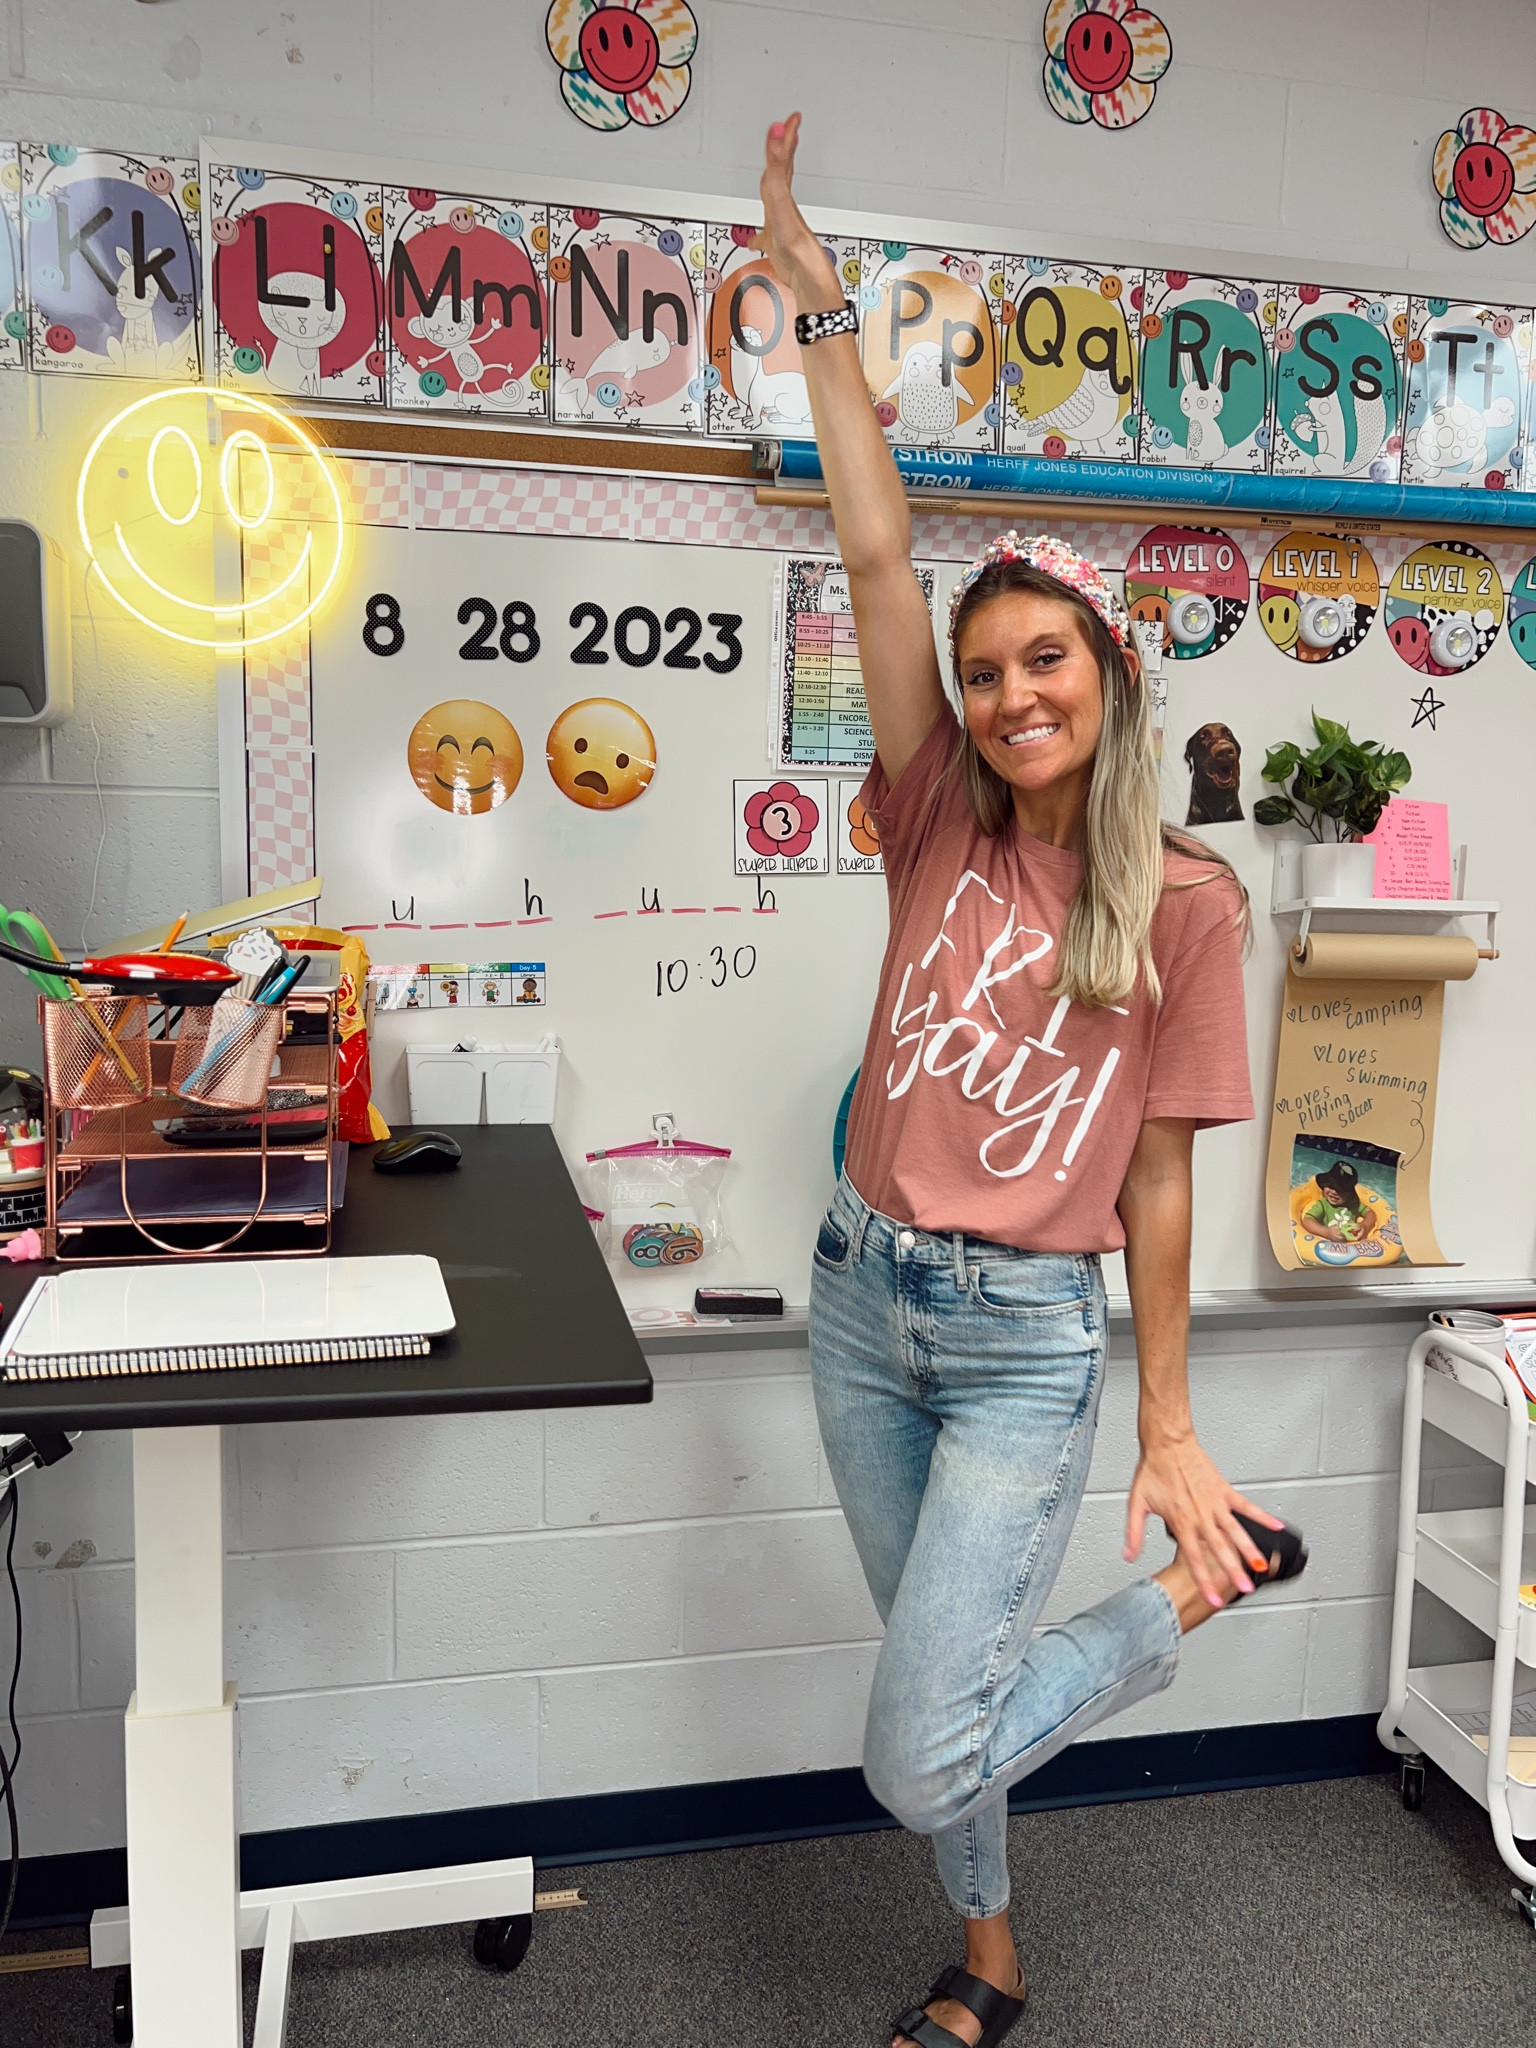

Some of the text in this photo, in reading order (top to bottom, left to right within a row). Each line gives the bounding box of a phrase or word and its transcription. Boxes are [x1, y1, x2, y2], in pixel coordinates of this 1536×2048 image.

[57, 202, 179, 303] Kk
[393, 239, 542, 330] Mm
[570, 243, 688, 347] Nn
[889, 279, 985, 388] Pp
[34, 356, 85, 370] kangaroo
[1168, 310, 1257, 393] Rr
[1298, 320, 1384, 401] Ss
[223, 379, 241, 389] lion
[1432, 332, 1506, 409] Tt
[394, 397, 431, 407] monkey
[557, 410, 595, 421] narwhal
[711, 422, 736, 432] otter
[1006, 443, 1026, 453] quail
[1141, 455, 1167, 464] rabbit
[892, 448, 1213, 484] STROM HERFF JONES EDUCATION DIVISION
[1274, 466, 1307, 478] squirrel
[1403, 475, 1425, 485] turtle
[1137, 543, 1209, 574] LEVEL
[1272, 549, 1342, 579] LEVEL
[829, 585, 848, 596] Ms.
[1206, 573, 1236, 588] silent
[1296, 578, 1378, 594] whisper voice
[1401, 562, 1495, 595] LEVEL 2
[1423, 593, 1502, 611] partner voice
[363, 593, 405, 656] 8
[457, 596, 541, 663] 28
[569, 601, 743, 674] 2023
[771, 805, 793, 836] 3
[738, 857, 777, 872] SUPER
[782, 857, 819, 872] HELPER
[839, 857, 875, 872] SUPER
[519, 964, 531, 972] Day
[656, 944, 757, 998] 10:30
[1298, 997, 1352, 1024] Loves
[1325, 1043, 1378, 1065] Loves
[1286, 1085, 1331, 1114] Loves
